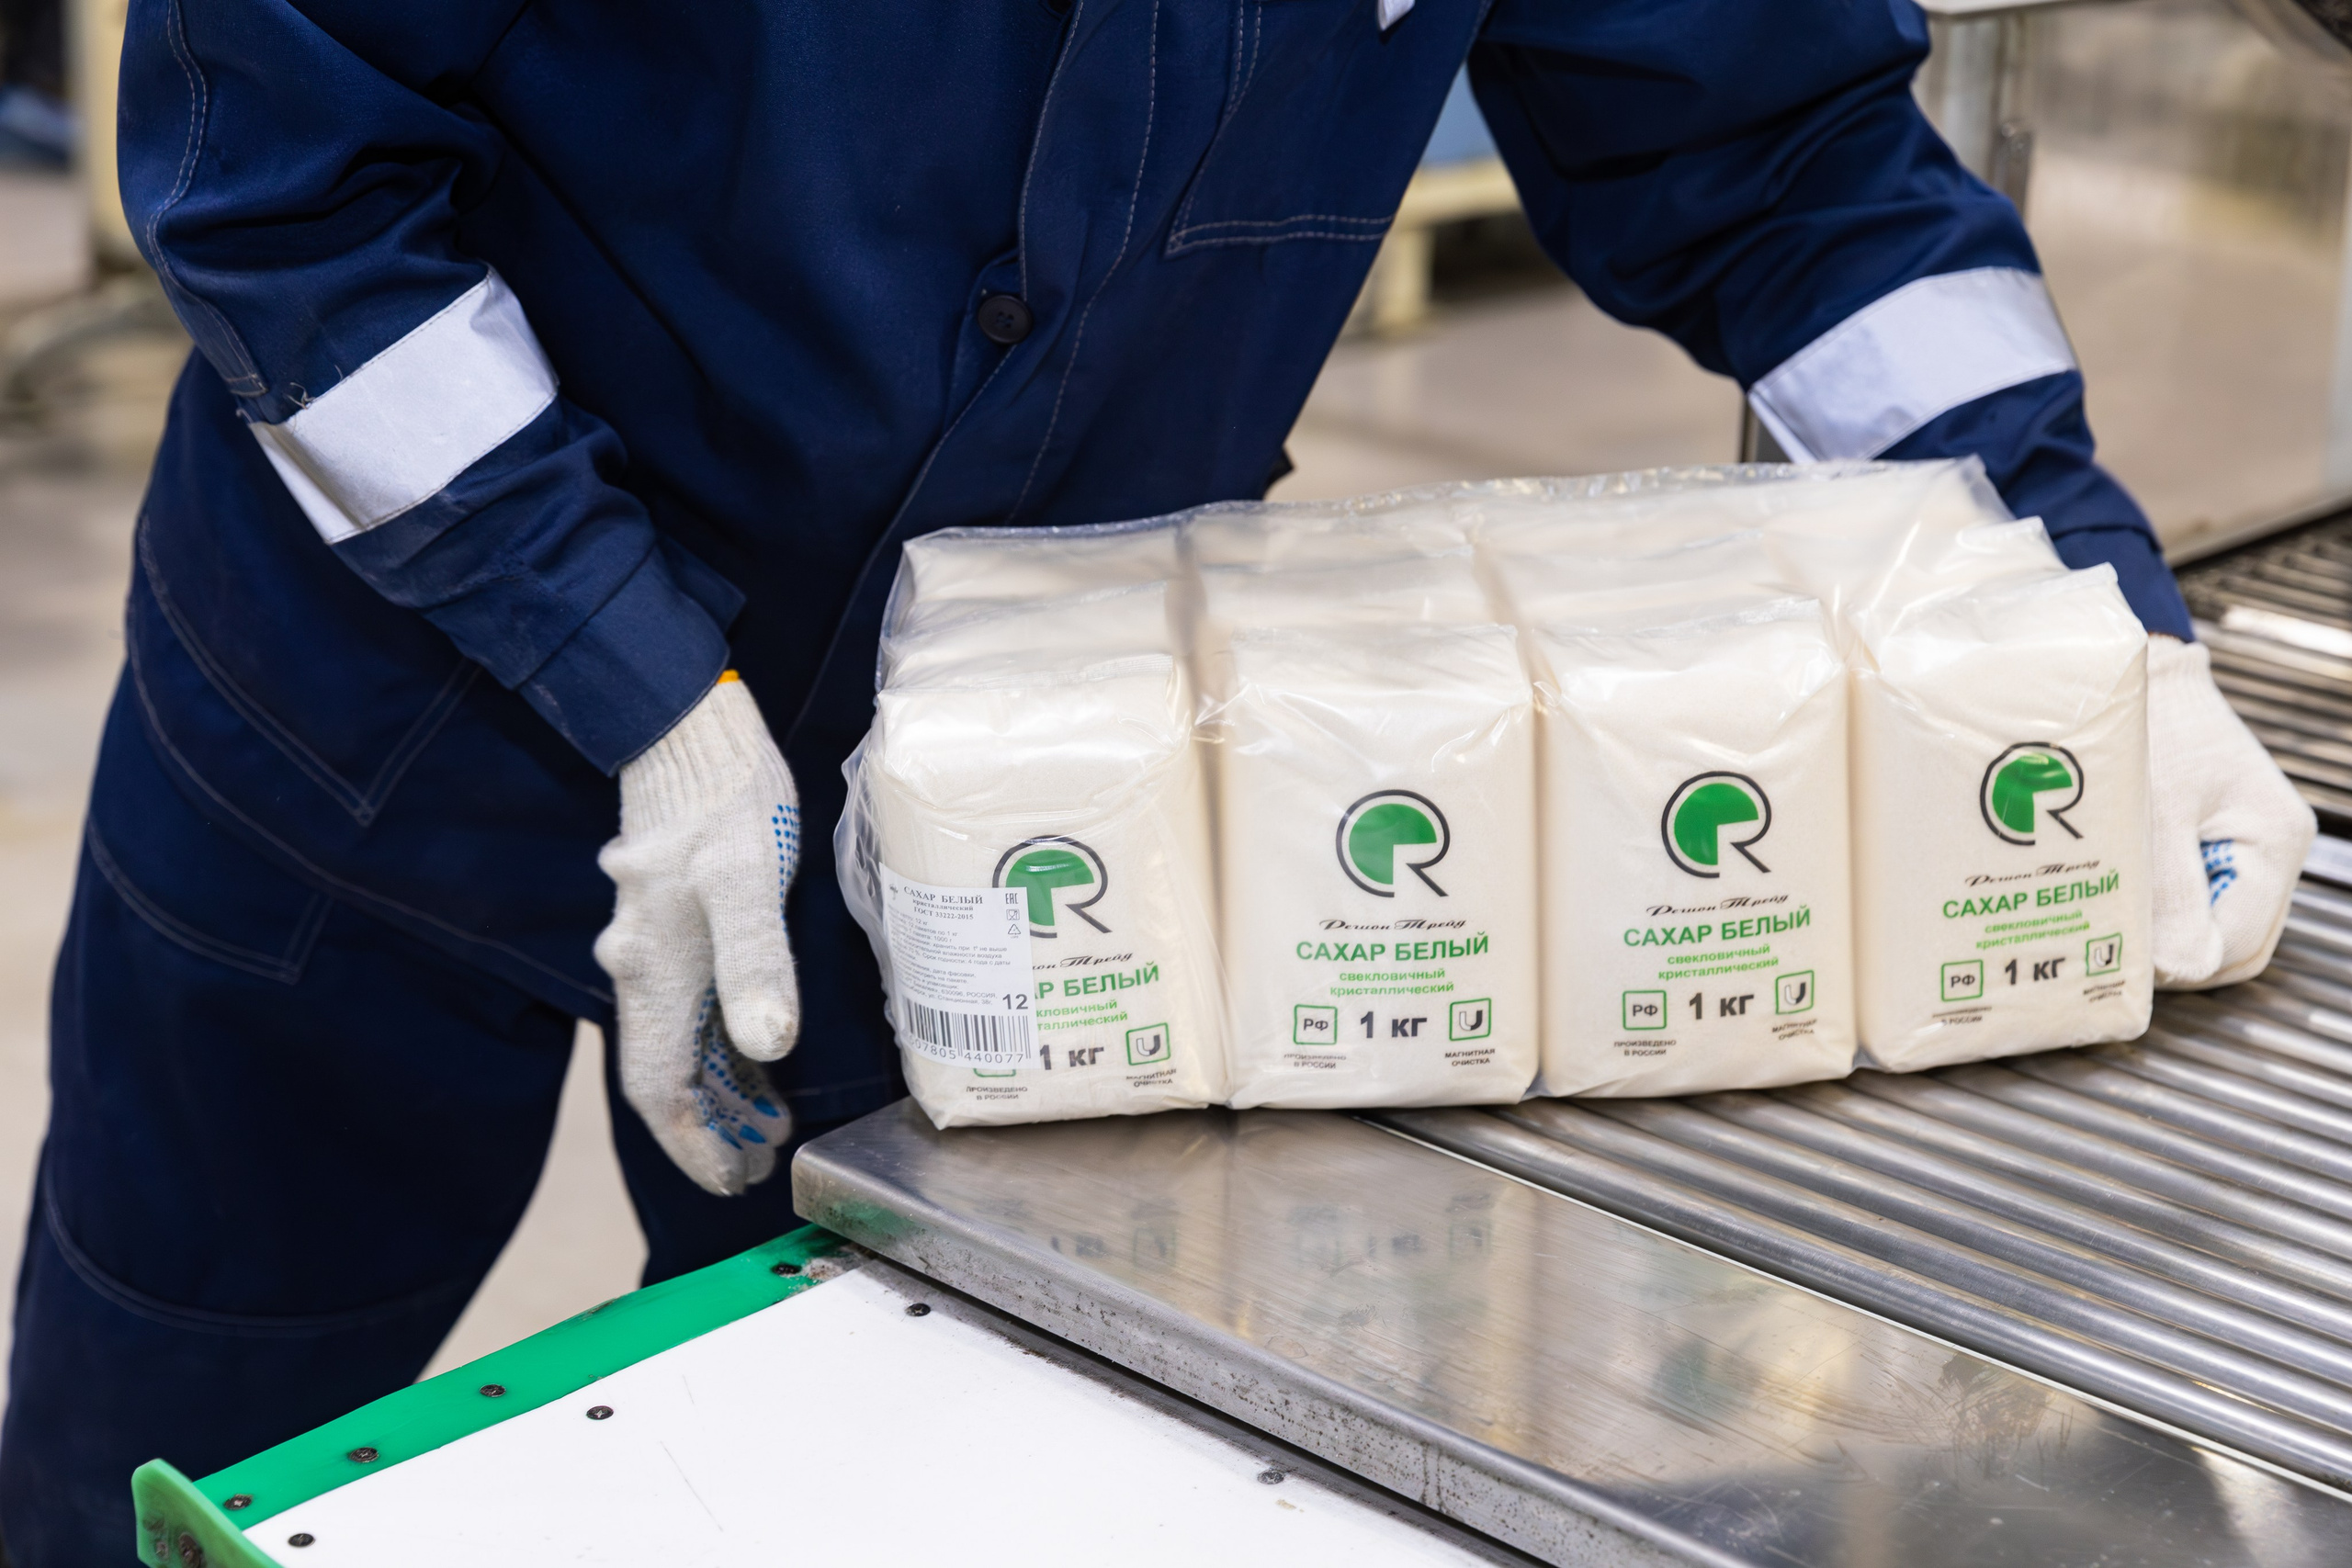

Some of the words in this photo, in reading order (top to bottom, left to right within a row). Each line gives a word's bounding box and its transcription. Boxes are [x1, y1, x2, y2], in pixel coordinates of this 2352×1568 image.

[904, 886, 935, 901] САХАР
[941, 895, 983, 904] БЕЛЫЙ
[1942, 892, 2027, 919] САХАР
[2036, 869, 2119, 908] БЕЛЫЙ
[912, 898, 974, 911] кристаллический
[913, 907, 933, 917] ГОСТ
[935, 911, 974, 920] 33222-2015
[1623, 924, 1713, 947] САХАР
[1722, 905, 1811, 941] БЕЛЫЙ
[1984, 909, 2084, 934] свекловичный
[1975, 920, 2091, 950] кристаллический
[1296, 941, 1385, 962] САХАР
[1395, 931, 1489, 962] БЕЛЫЙ
[1667, 944, 1771, 964] свекловичный
[1340, 967, 1445, 981] свекловичный
[1658, 957, 1779, 981] кристаллический
[2005, 959, 2018, 986] 1
[2032, 957, 2065, 981] кг
[1063, 961, 1159, 997] БЕЛЫЙ
[1951, 974, 1975, 987] РФ
[1330, 982, 1454, 998] кристаллический
[1002, 994, 1029, 1010] 12
[1036, 999, 1117, 1018] кловичный
[1633, 1003, 1658, 1017] РФ
[1689, 992, 1703, 1020] 1
[1720, 994, 1755, 1018] кг
[1037, 1011, 1128, 1031] таллический
[1303, 1018, 1329, 1031] РФ
[1360, 1011, 1374, 1039] 1
[1391, 1017, 1428, 1038] кг
[1613, 1039, 1677, 1047] ПРОИЗВЕДЕНО
[965, 1053, 1023, 1064] 440077
[1040, 1044, 1051, 1071] 1
[1069, 1046, 1104, 1067] кг
[1444, 1048, 1496, 1058] МАГНИТНАЯ
[1301, 1061, 1336, 1069] РОССИИ
